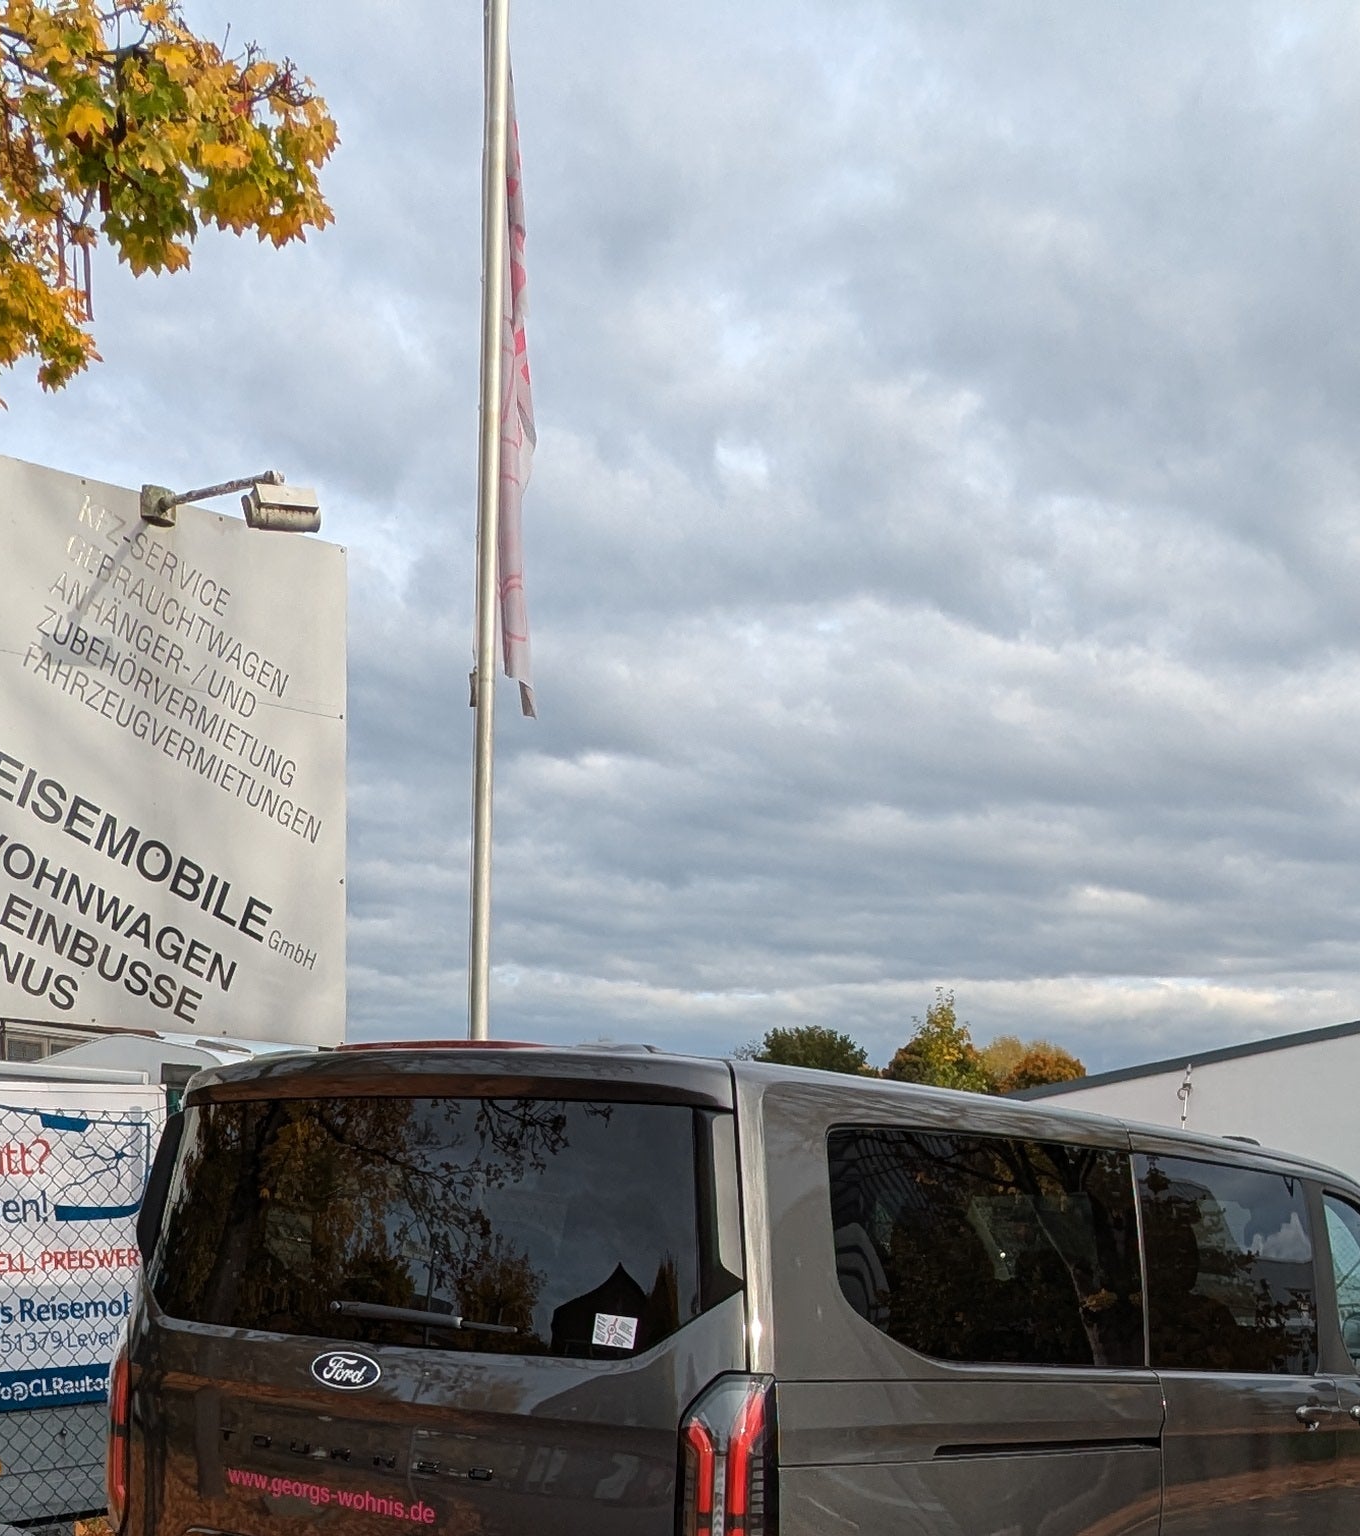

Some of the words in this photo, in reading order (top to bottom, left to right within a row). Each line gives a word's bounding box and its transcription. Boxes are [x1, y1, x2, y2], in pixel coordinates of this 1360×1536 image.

[37, 604, 297, 788] ZUBEHÖRVERMIETUNG
[22, 641, 322, 844] FAHRZEUGVERMIETUNGEN
[267, 929, 318, 971] GmbH
[40, 1246, 141, 1271] PREISWER
[1, 1330, 62, 1354] 51379
[322, 1356, 366, 1383] Ford
[226, 1467, 436, 1524] www.georgs-wohnis.de
